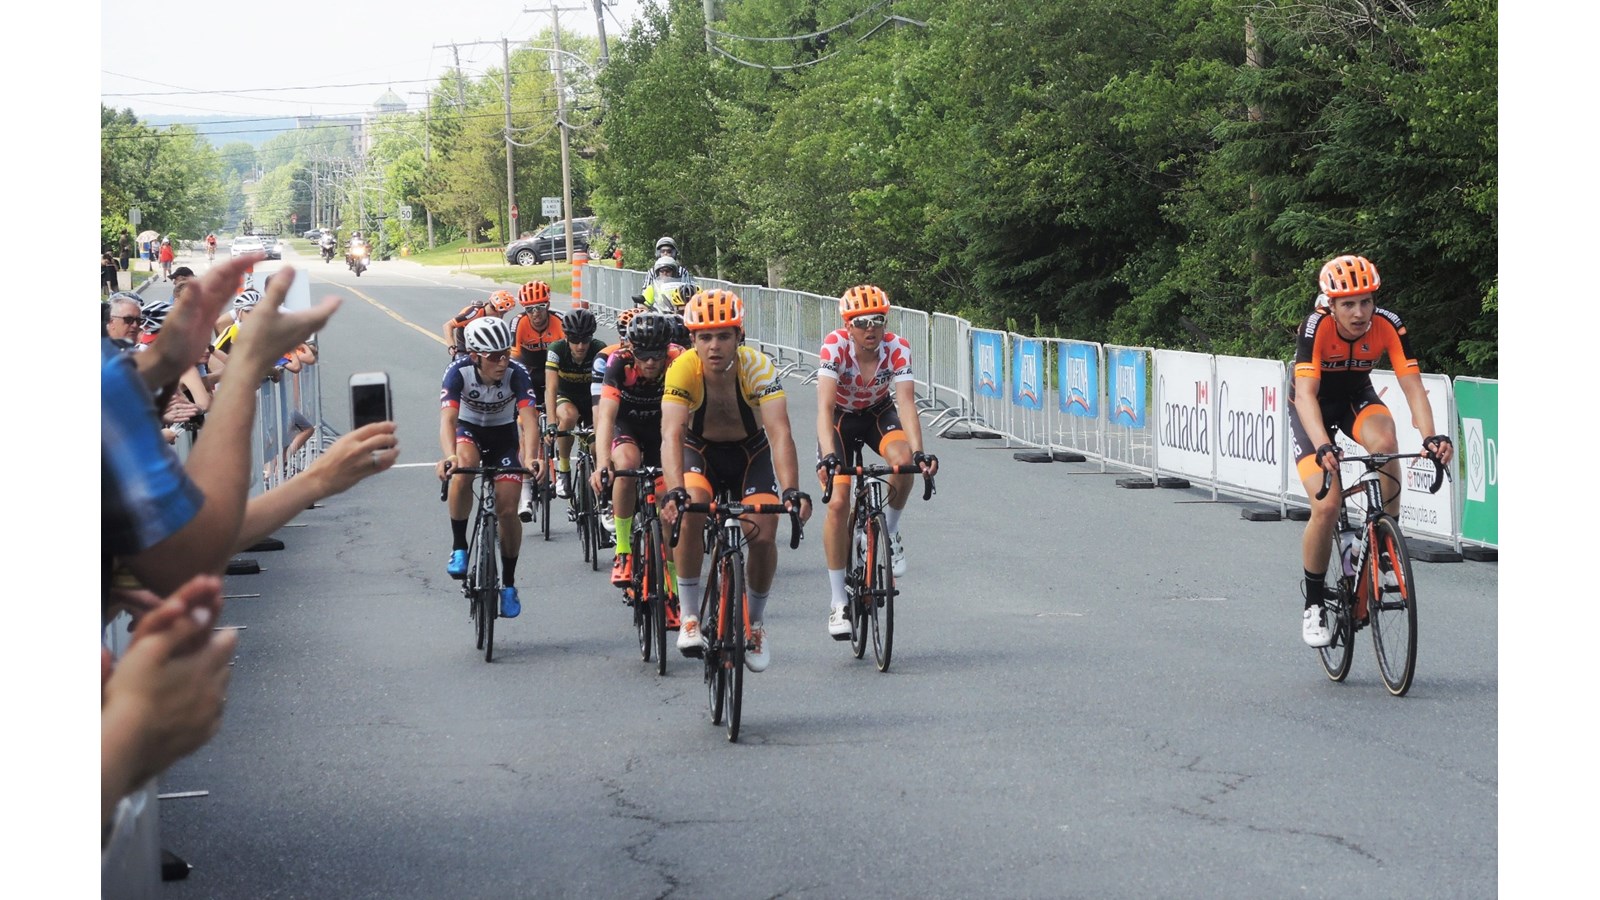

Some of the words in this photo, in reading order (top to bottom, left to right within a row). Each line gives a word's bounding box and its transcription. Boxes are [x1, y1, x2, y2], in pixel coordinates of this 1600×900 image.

[401, 210, 411, 220] 50
[1375, 306, 1400, 323] TOGURI
[1158, 374, 1210, 455] Canada
[1218, 380, 1277, 466] Canada
[1413, 471, 1435, 490] TOYOTA
